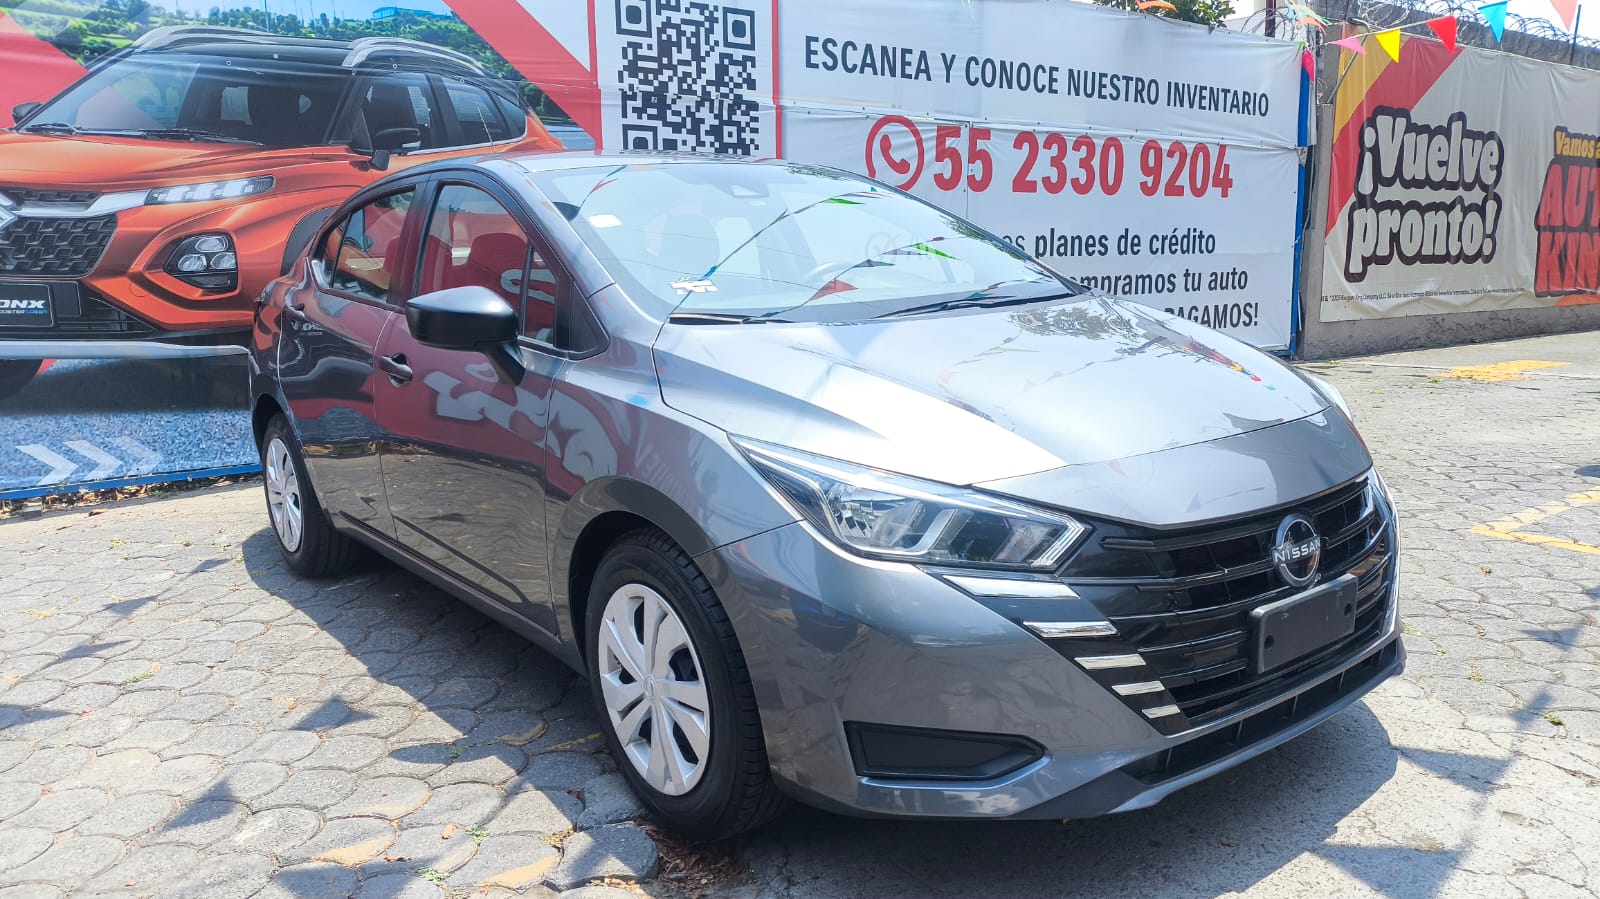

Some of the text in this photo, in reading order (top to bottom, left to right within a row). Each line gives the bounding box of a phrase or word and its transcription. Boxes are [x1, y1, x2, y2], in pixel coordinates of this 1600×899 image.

[804, 35, 1269, 117] ESCANEA Y CONOCE NUESTRO INVENTARIO
[1356, 109, 1502, 196] ¡Vuelve
[1555, 131, 1594, 158] Vamos
[933, 125, 1233, 198] 55 2330 9204
[1034, 228, 1109, 259] planes
[1117, 228, 1141, 256] de
[1149, 227, 1216, 255] crédito
[1347, 197, 1500, 278] pronto!
[1069, 267, 1248, 296] mpramos tu auto
[0, 299, 46, 309] ONX
[1164, 302, 1259, 330] GAMOS!
[1274, 538, 1321, 563] NISSAN
